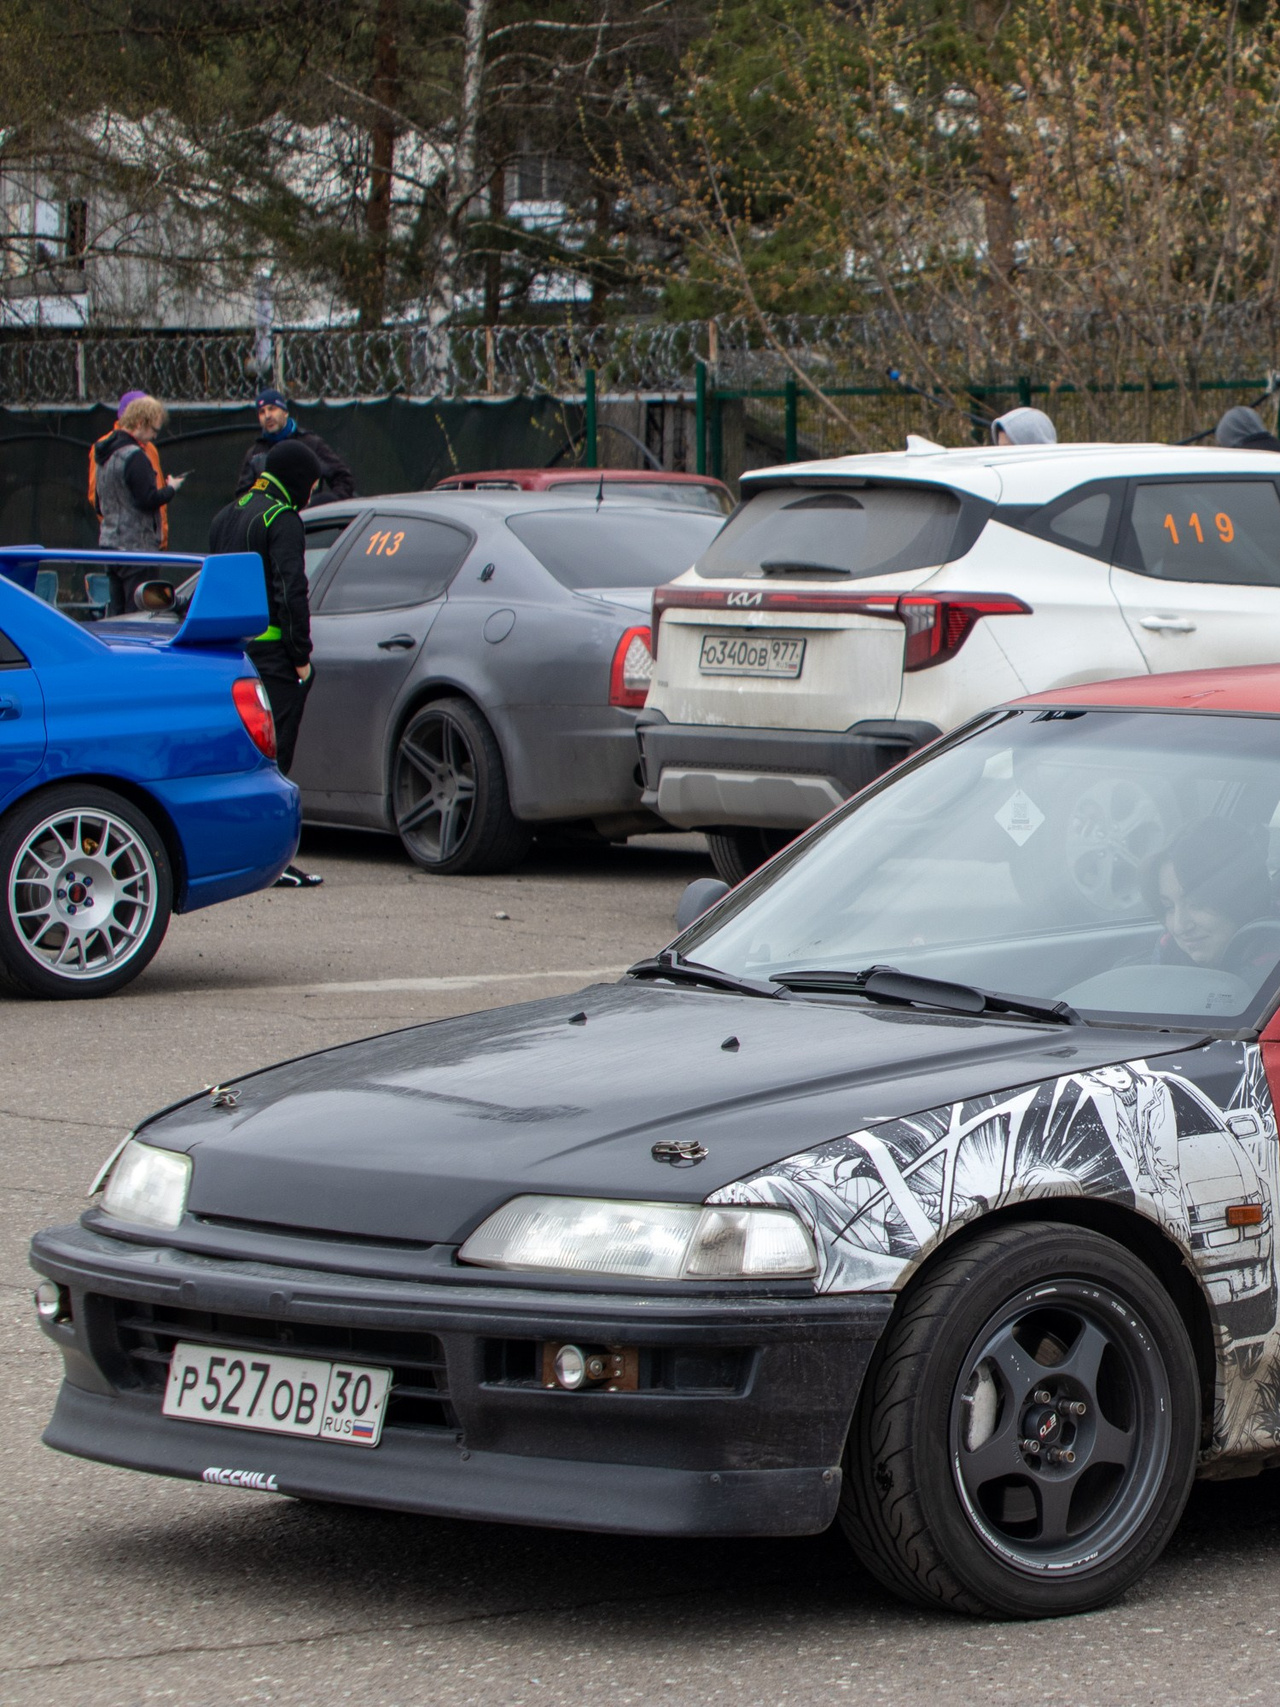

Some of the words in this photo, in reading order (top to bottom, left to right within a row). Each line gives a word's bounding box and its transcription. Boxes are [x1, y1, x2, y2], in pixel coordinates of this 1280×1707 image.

[1164, 512, 1234, 544] 119
[366, 530, 405, 556] 113
[706, 641, 768, 666] О340ОВ
[772, 642, 798, 661] 977
[178, 1356, 318, 1425] Р527ОВ
[331, 1370, 372, 1417] 30
[324, 1416, 352, 1434] RUS
